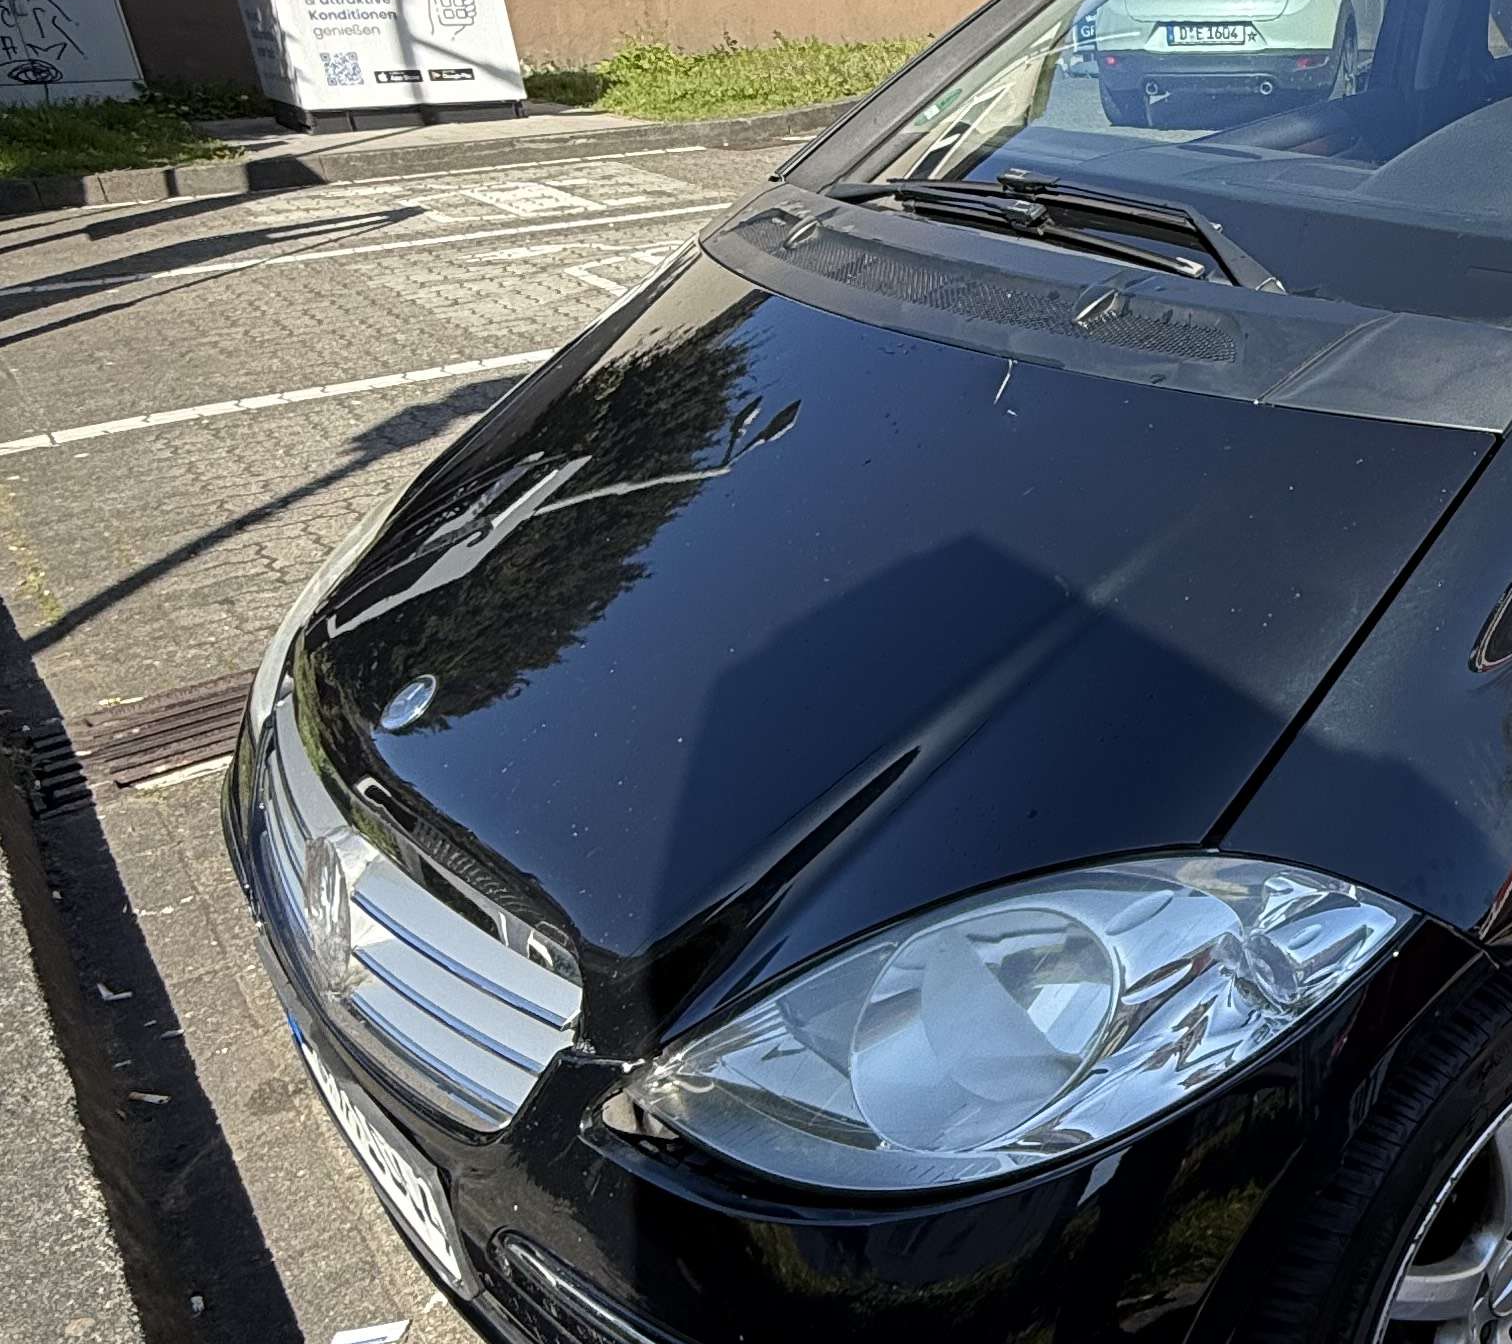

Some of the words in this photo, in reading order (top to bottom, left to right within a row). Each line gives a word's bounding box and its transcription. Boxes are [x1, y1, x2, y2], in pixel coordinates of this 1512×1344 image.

[308, 8, 398, 21] Konditionen
[313, 23, 381, 40] genießen
[1207, 26, 1238, 40] 1604
